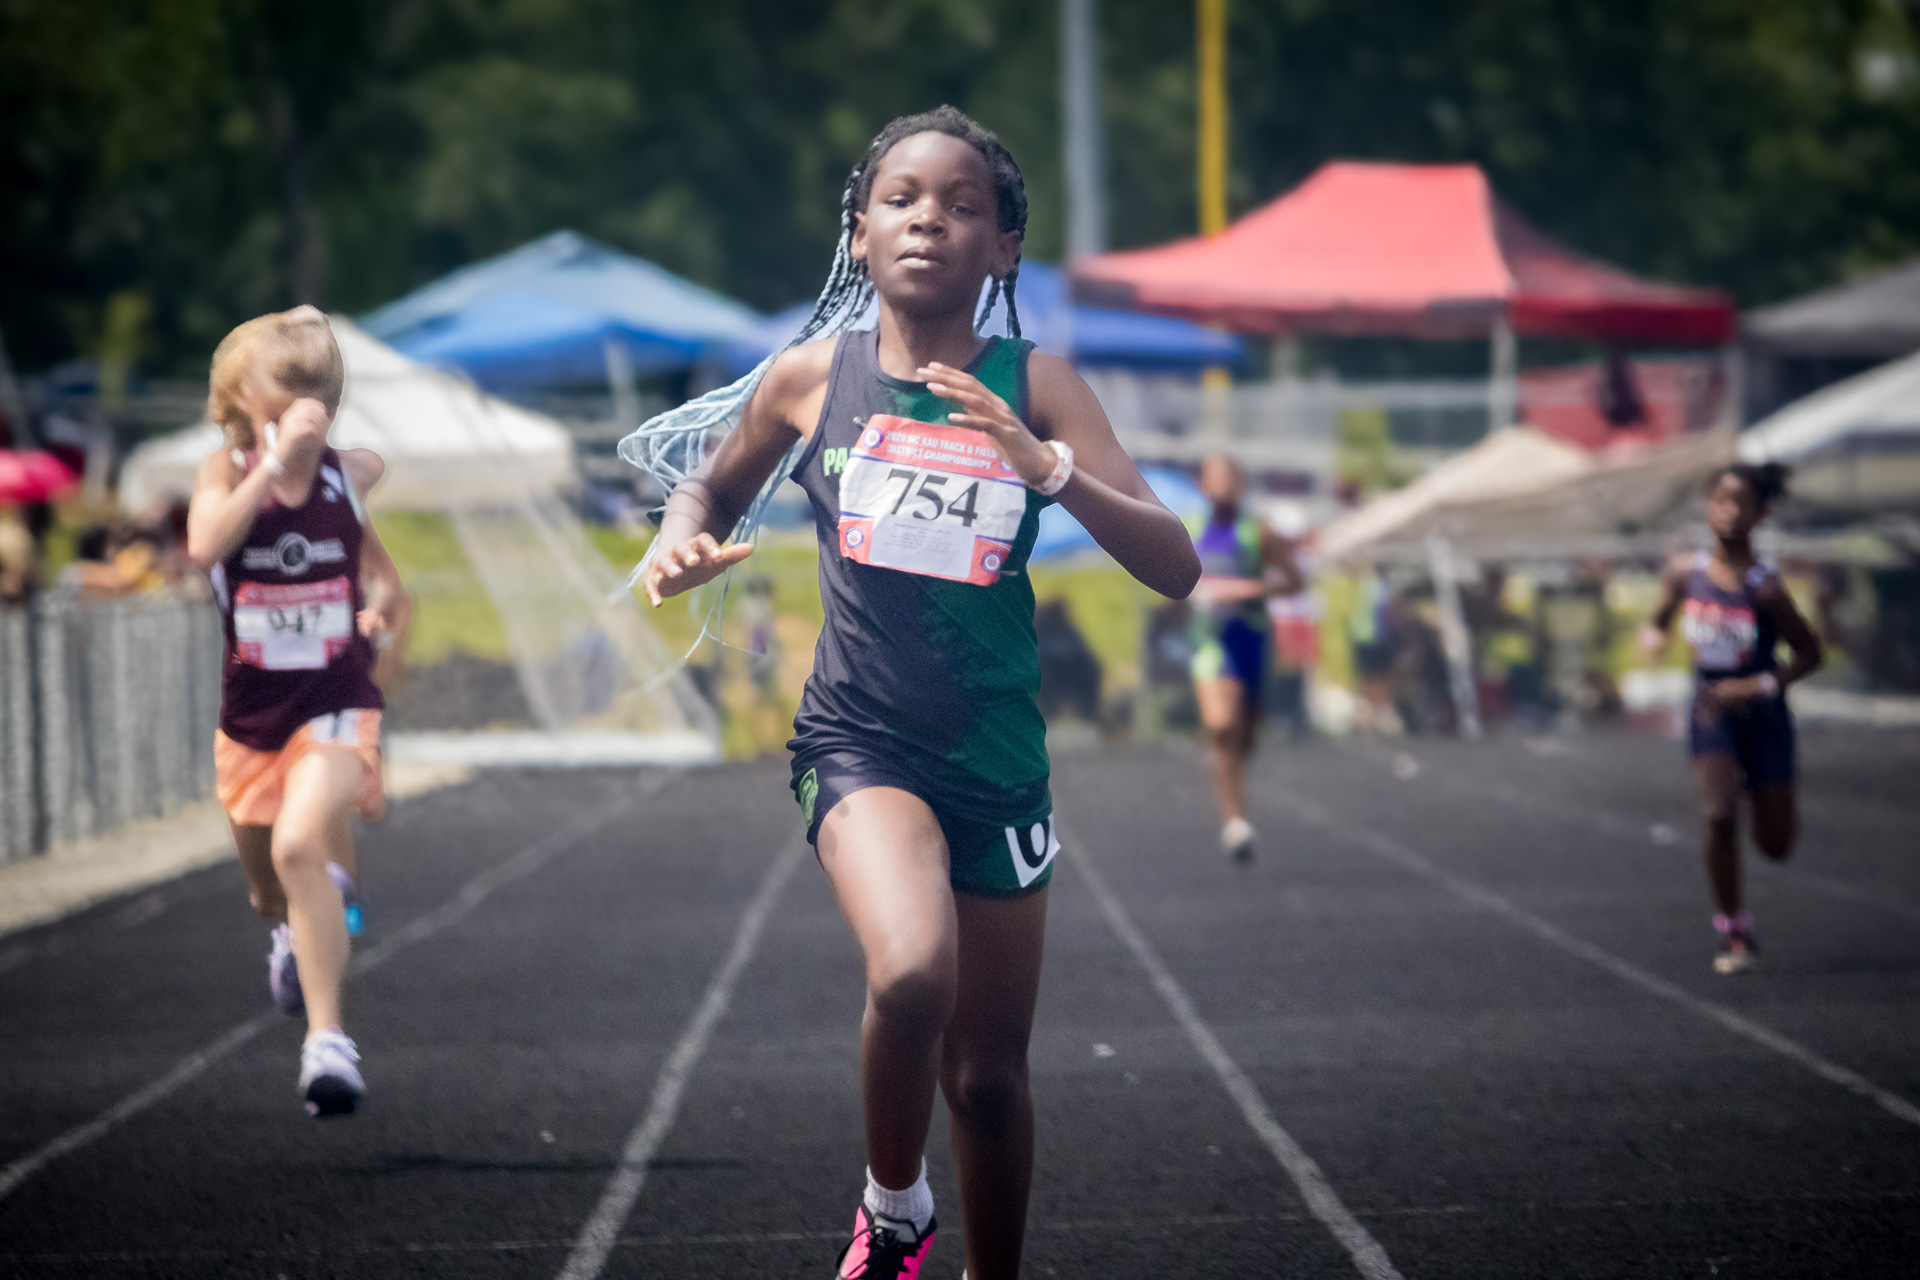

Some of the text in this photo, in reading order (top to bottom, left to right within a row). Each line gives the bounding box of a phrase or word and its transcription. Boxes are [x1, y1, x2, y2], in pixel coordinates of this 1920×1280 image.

[888, 444, 992, 470] DISTRICT CHAMPIONSHIPS
[908, 434, 921, 446] NC
[921, 437, 938, 447] AAU
[940, 440, 966, 452] TRACK
[967, 445, 973, 455] &
[975, 446, 998, 459] FIELD
[823, 447, 854, 477] PA
[886, 468, 979, 528] 754
